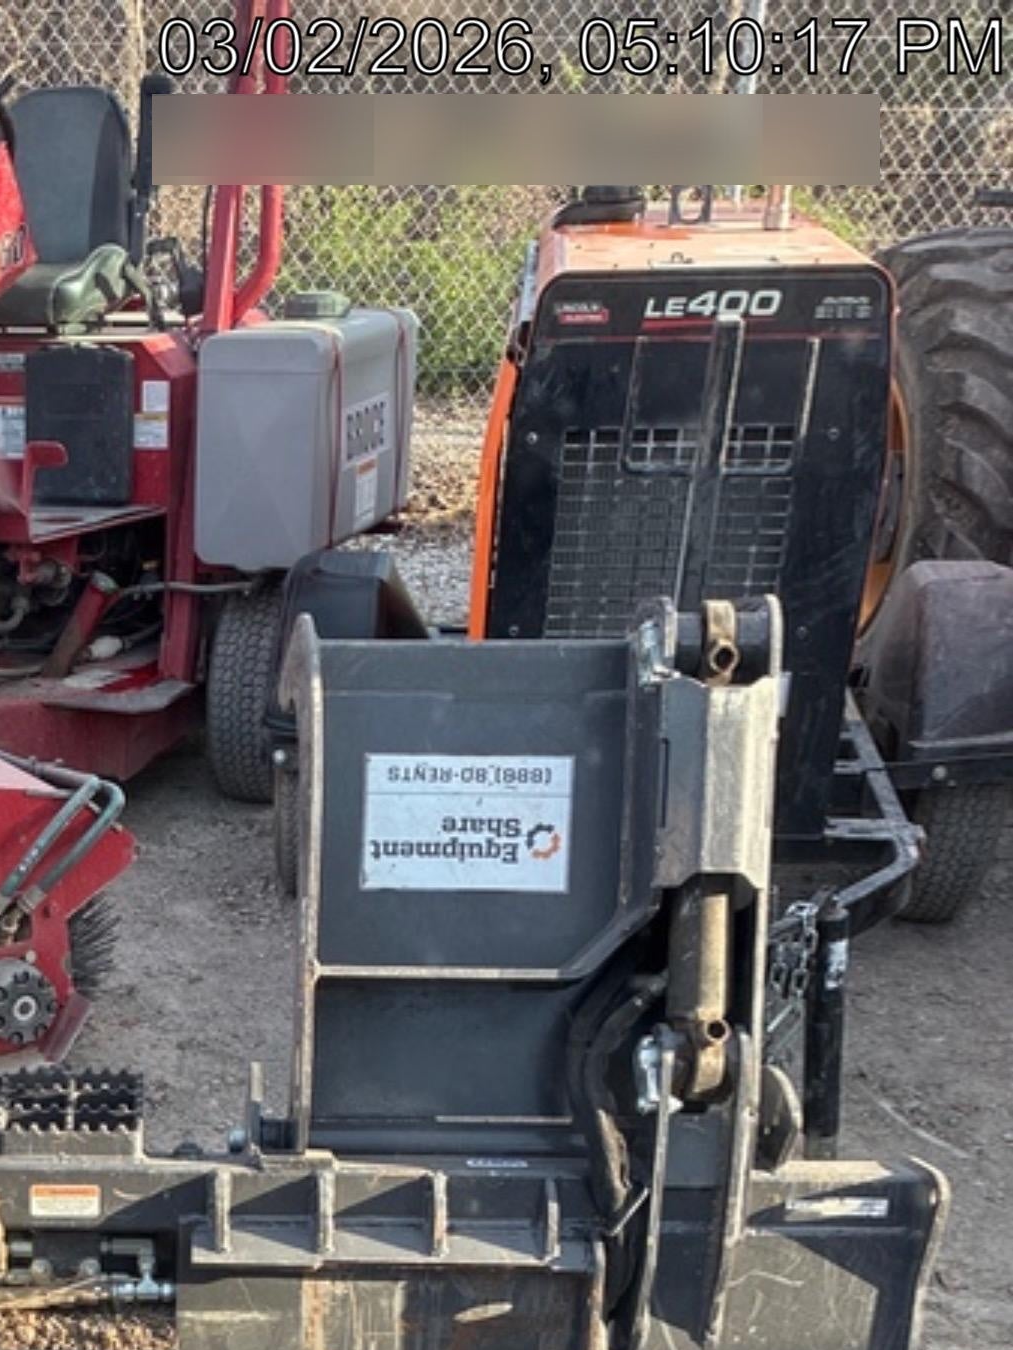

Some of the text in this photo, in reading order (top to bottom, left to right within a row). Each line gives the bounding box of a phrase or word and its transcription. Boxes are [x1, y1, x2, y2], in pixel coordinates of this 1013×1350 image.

[644, 290, 782, 319] LE400
[442, 817, 522, 839] Share
[369, 837, 520, 865] Equipment
